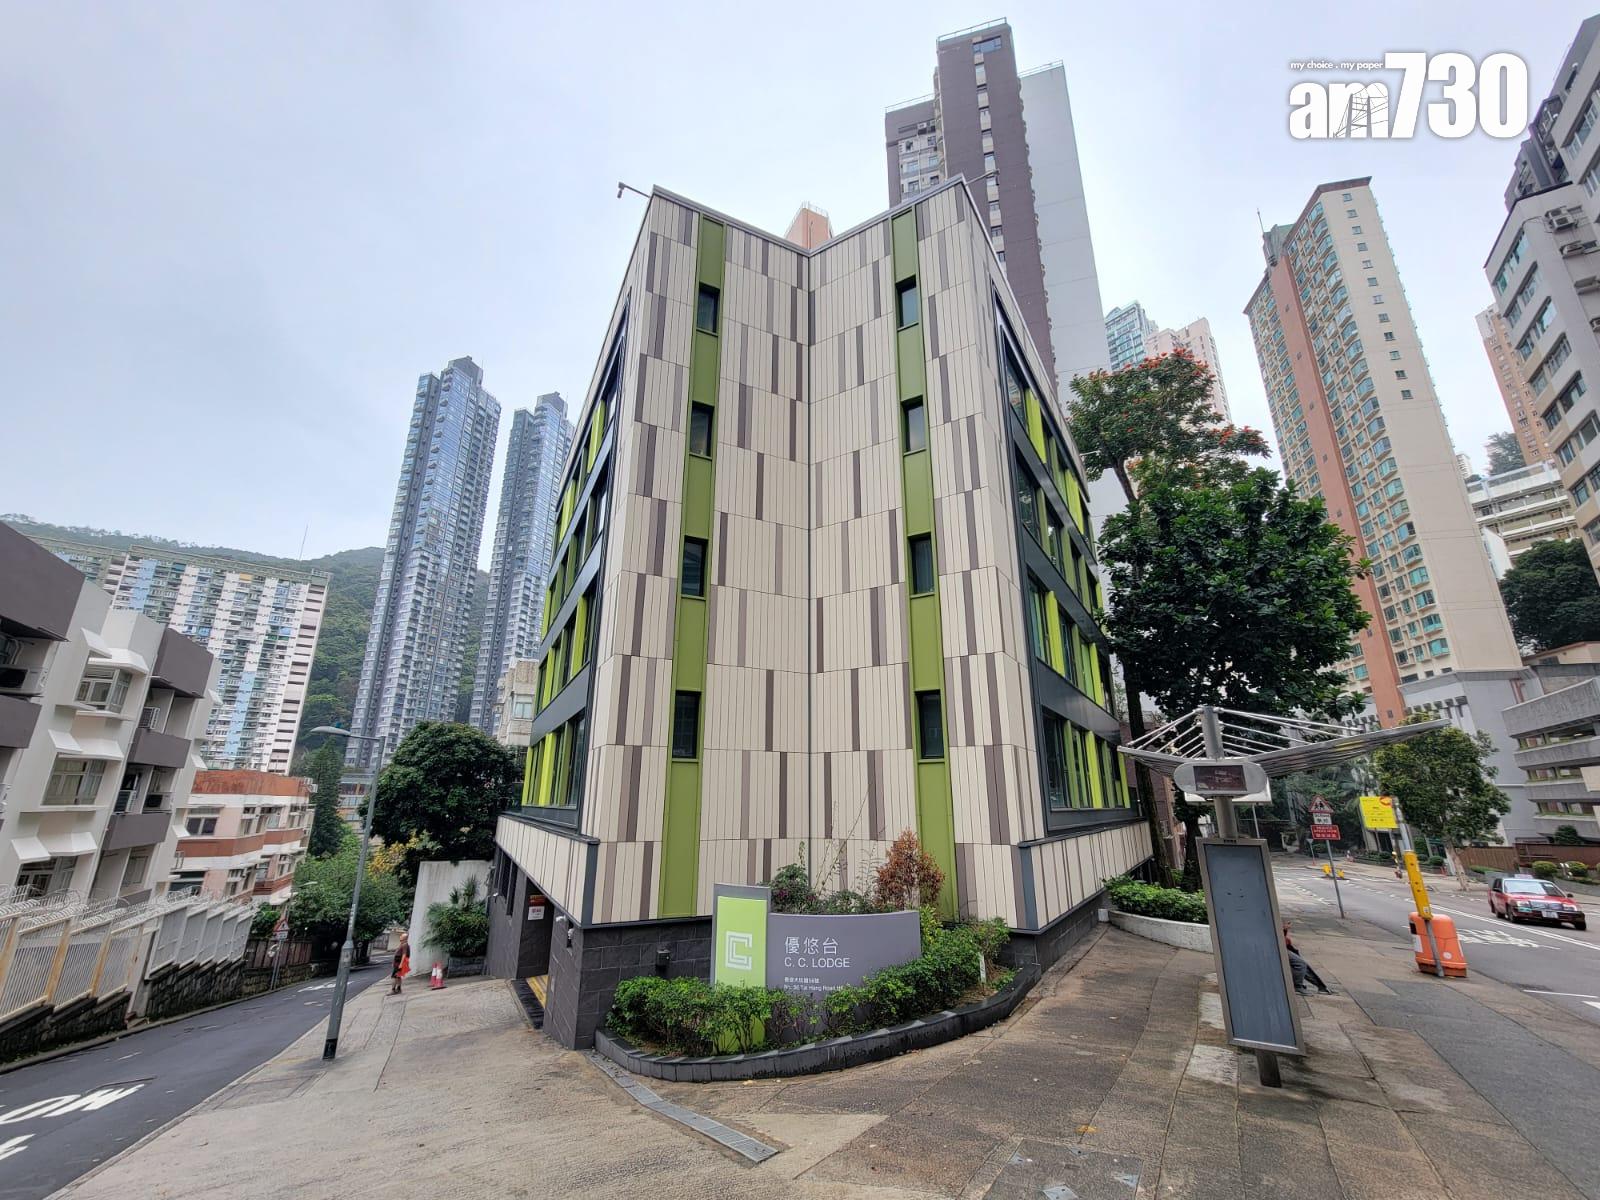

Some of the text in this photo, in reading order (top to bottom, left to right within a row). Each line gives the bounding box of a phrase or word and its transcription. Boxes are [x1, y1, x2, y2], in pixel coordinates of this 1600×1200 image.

[784, 936, 839, 955] 優悠台
[784, 957, 851, 968] C. C. LODGE
